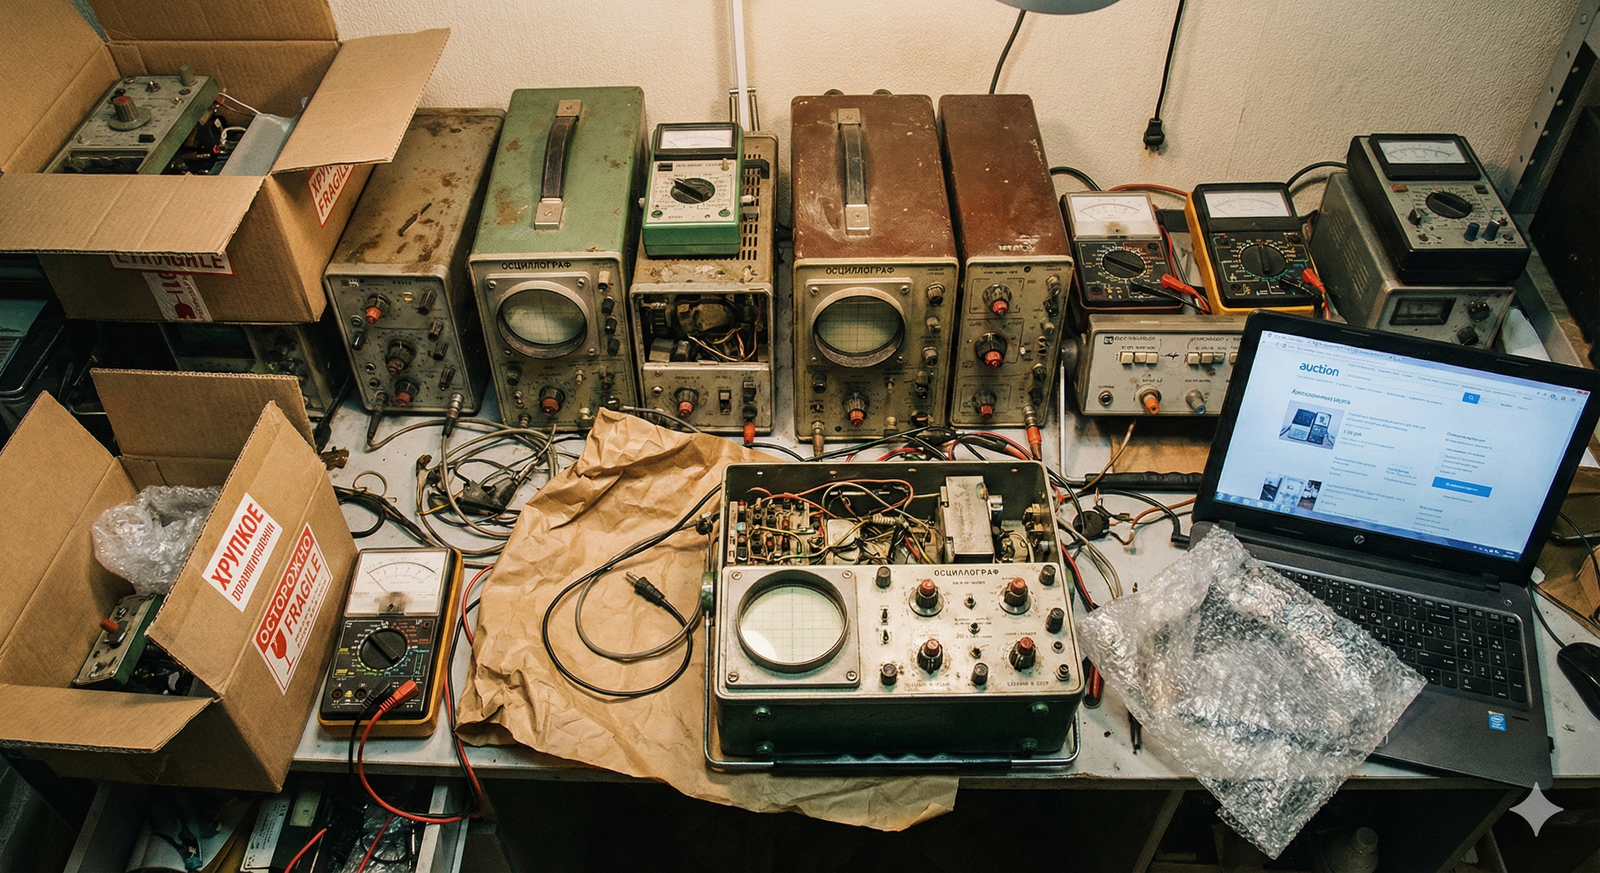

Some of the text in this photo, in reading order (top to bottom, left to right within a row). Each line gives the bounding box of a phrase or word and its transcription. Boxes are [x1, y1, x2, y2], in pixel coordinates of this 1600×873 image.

[318, 165, 349, 217] FRAGIL
[501, 261, 572, 270] ОСЦИЛЛОГРАФ
[825, 266, 895, 275] ОСЦИЛЛОГРАФ
[1299, 362, 1340, 377] auction
[211, 502, 264, 591] ХРУПКОЕ
[260, 534, 311, 645] ОСТОРОЖНО
[933, 569, 1000, 577] ОСЦИЛЛОГРАФ
[284, 552, 322, 636] FRAGILE
